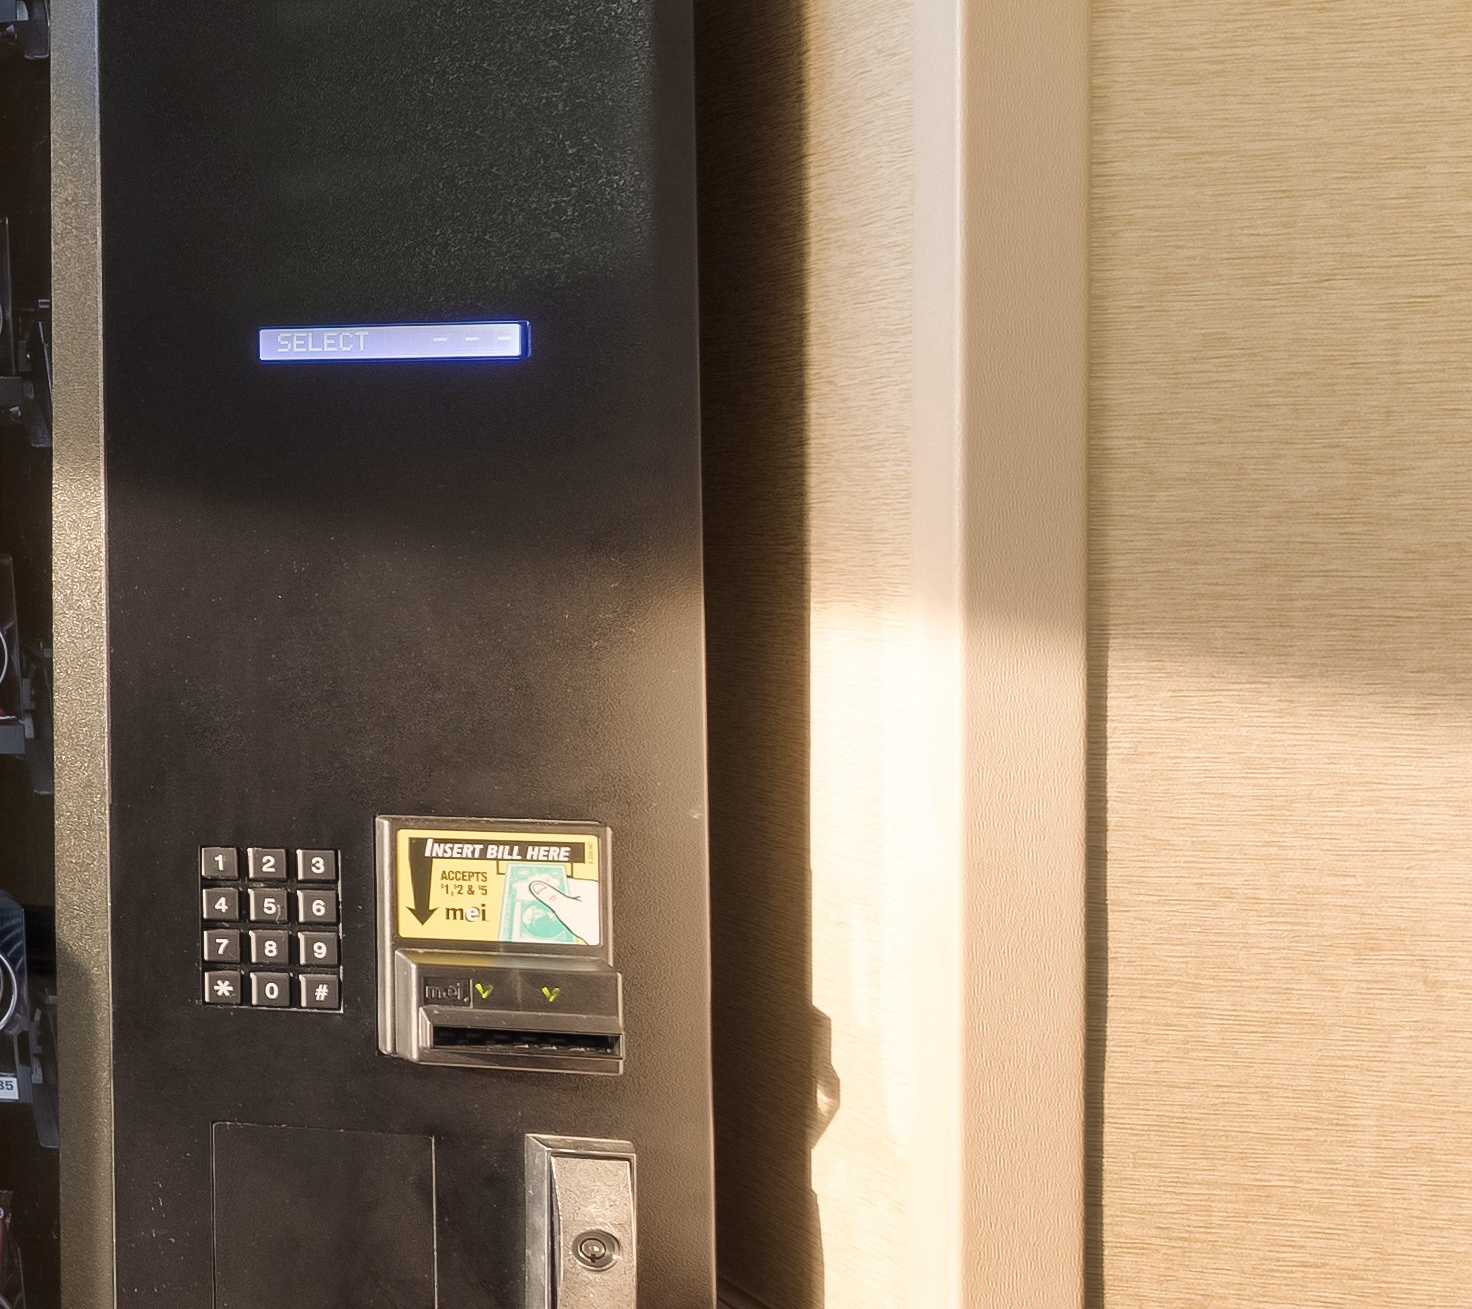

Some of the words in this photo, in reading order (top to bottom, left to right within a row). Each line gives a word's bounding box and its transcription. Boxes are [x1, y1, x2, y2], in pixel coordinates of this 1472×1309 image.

[276, 330, 369, 352] SELECT
[424, 838, 484, 859] INSERT
[486, 844, 523, 860] BILL
[526, 845, 572, 862] HERE
[214, 854, 225, 872] 1
[262, 856, 276, 874] 2
[310, 857, 325, 874] 3
[440, 870, 488, 882] ACCEPTS
[466, 886, 476, 896] &
[214, 896, 228, 913] 4
[262, 897, 276, 914] 5
[312, 899, 325, 916] 6
[445, 903, 487, 923] mei
[215, 938, 229, 955] 7
[264, 940, 277, 957] 8
[313, 941, 327, 959] 9
[265, 982, 278, 999] 0
